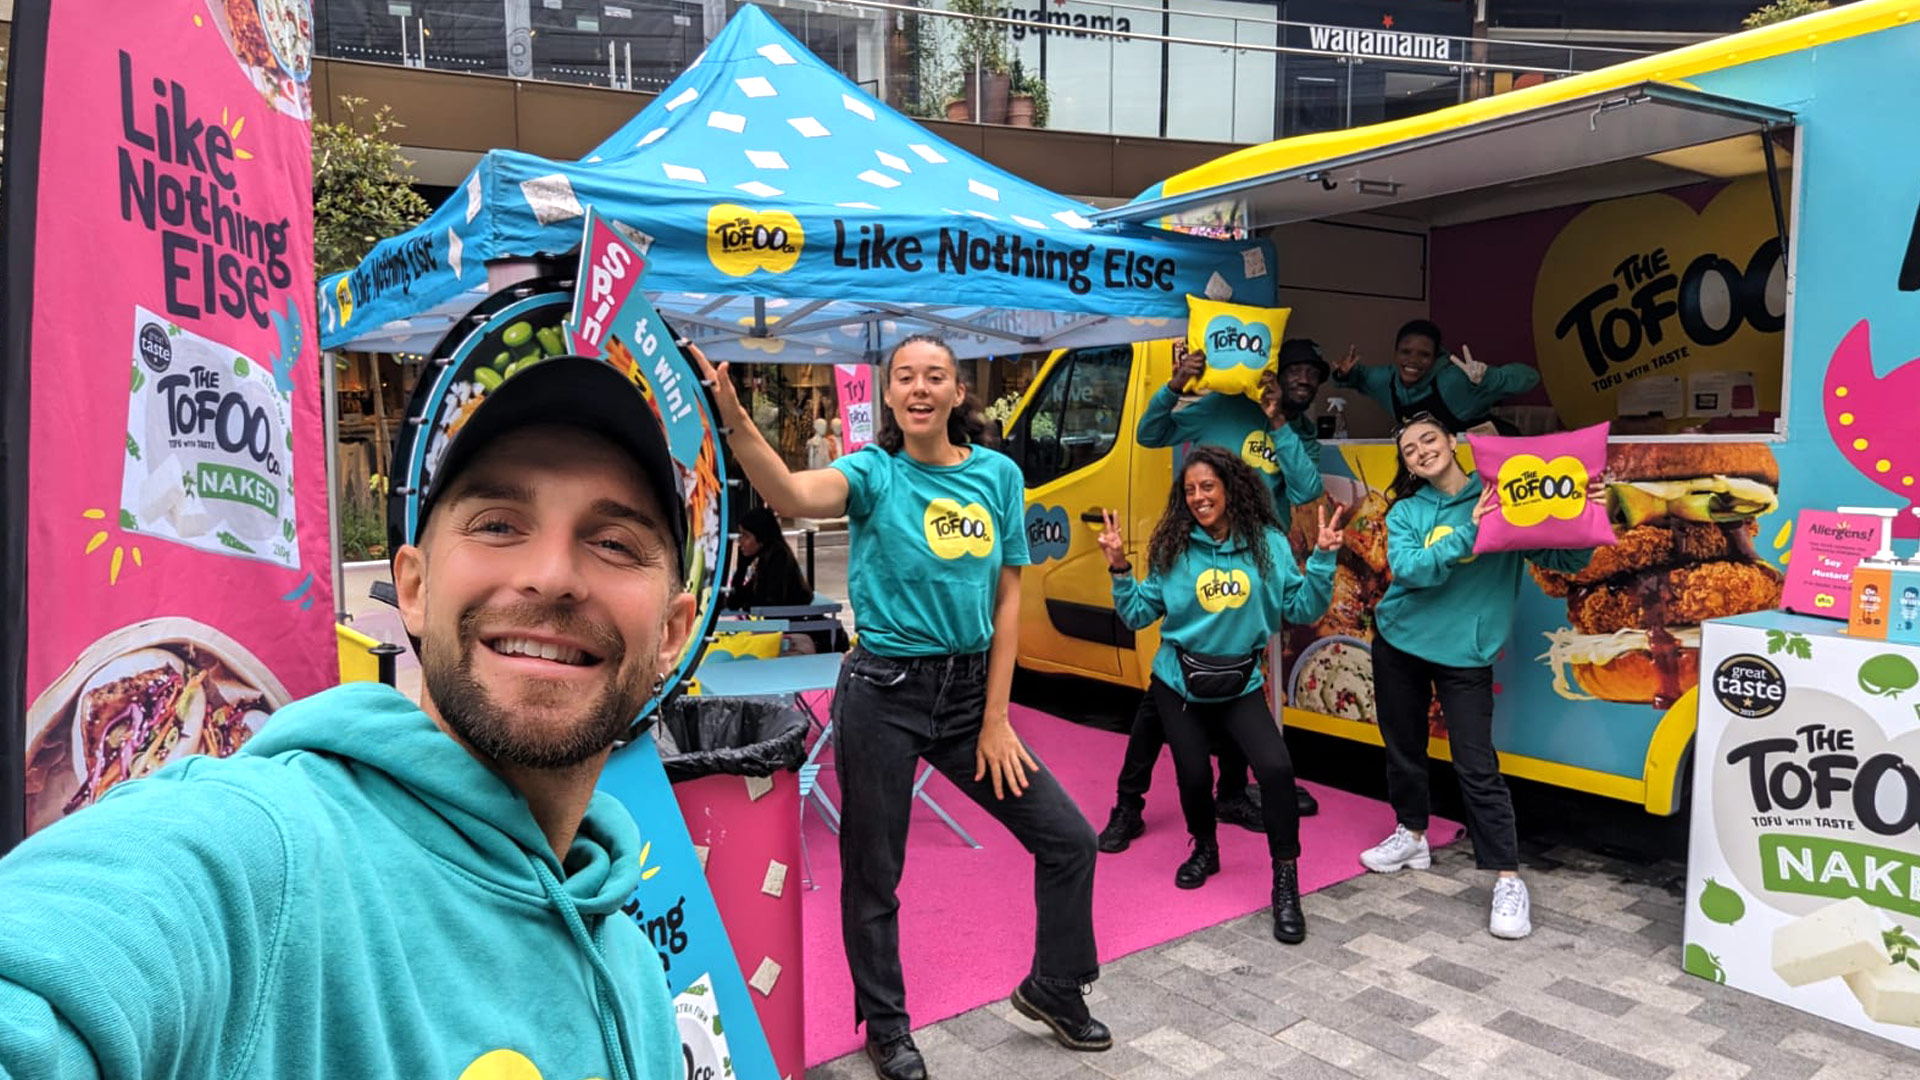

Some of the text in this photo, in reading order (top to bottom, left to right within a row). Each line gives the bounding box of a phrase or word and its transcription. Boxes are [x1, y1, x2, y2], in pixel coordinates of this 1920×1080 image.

[988, 7, 1131, 42] agamama
[1310, 27, 1449, 59] wagamama
[119, 49, 236, 190] Like
[118, 146, 291, 288] Nothing
[834, 219, 1176, 295] Like Nothing Else
[1613, 247, 1671, 291] THE
[162, 230, 270, 329] Else
[579, 242, 632, 347] Spin
[142, 337, 170, 361] taste
[190, 366, 219, 388] THE
[634, 317, 658, 357] to
[653, 356, 692, 424] win!
[1592, 346, 1691, 393] TOFU WITH TASTE
[844, 380, 866, 402] Try
[202, 470, 276, 509] NAKED
[1809, 523, 1875, 542] Allergens!
[1812, 569, 1850, 581] Mustard
[1824, 558, 1842, 568] Soy
[1717, 675, 1783, 701] taste
[1732, 667, 1767, 680] great
[1796, 724, 1855, 753] THE
[1726, 738, 1920, 836] TOFO
[1752, 816, 1856, 830] TOFU WITH TASTE
